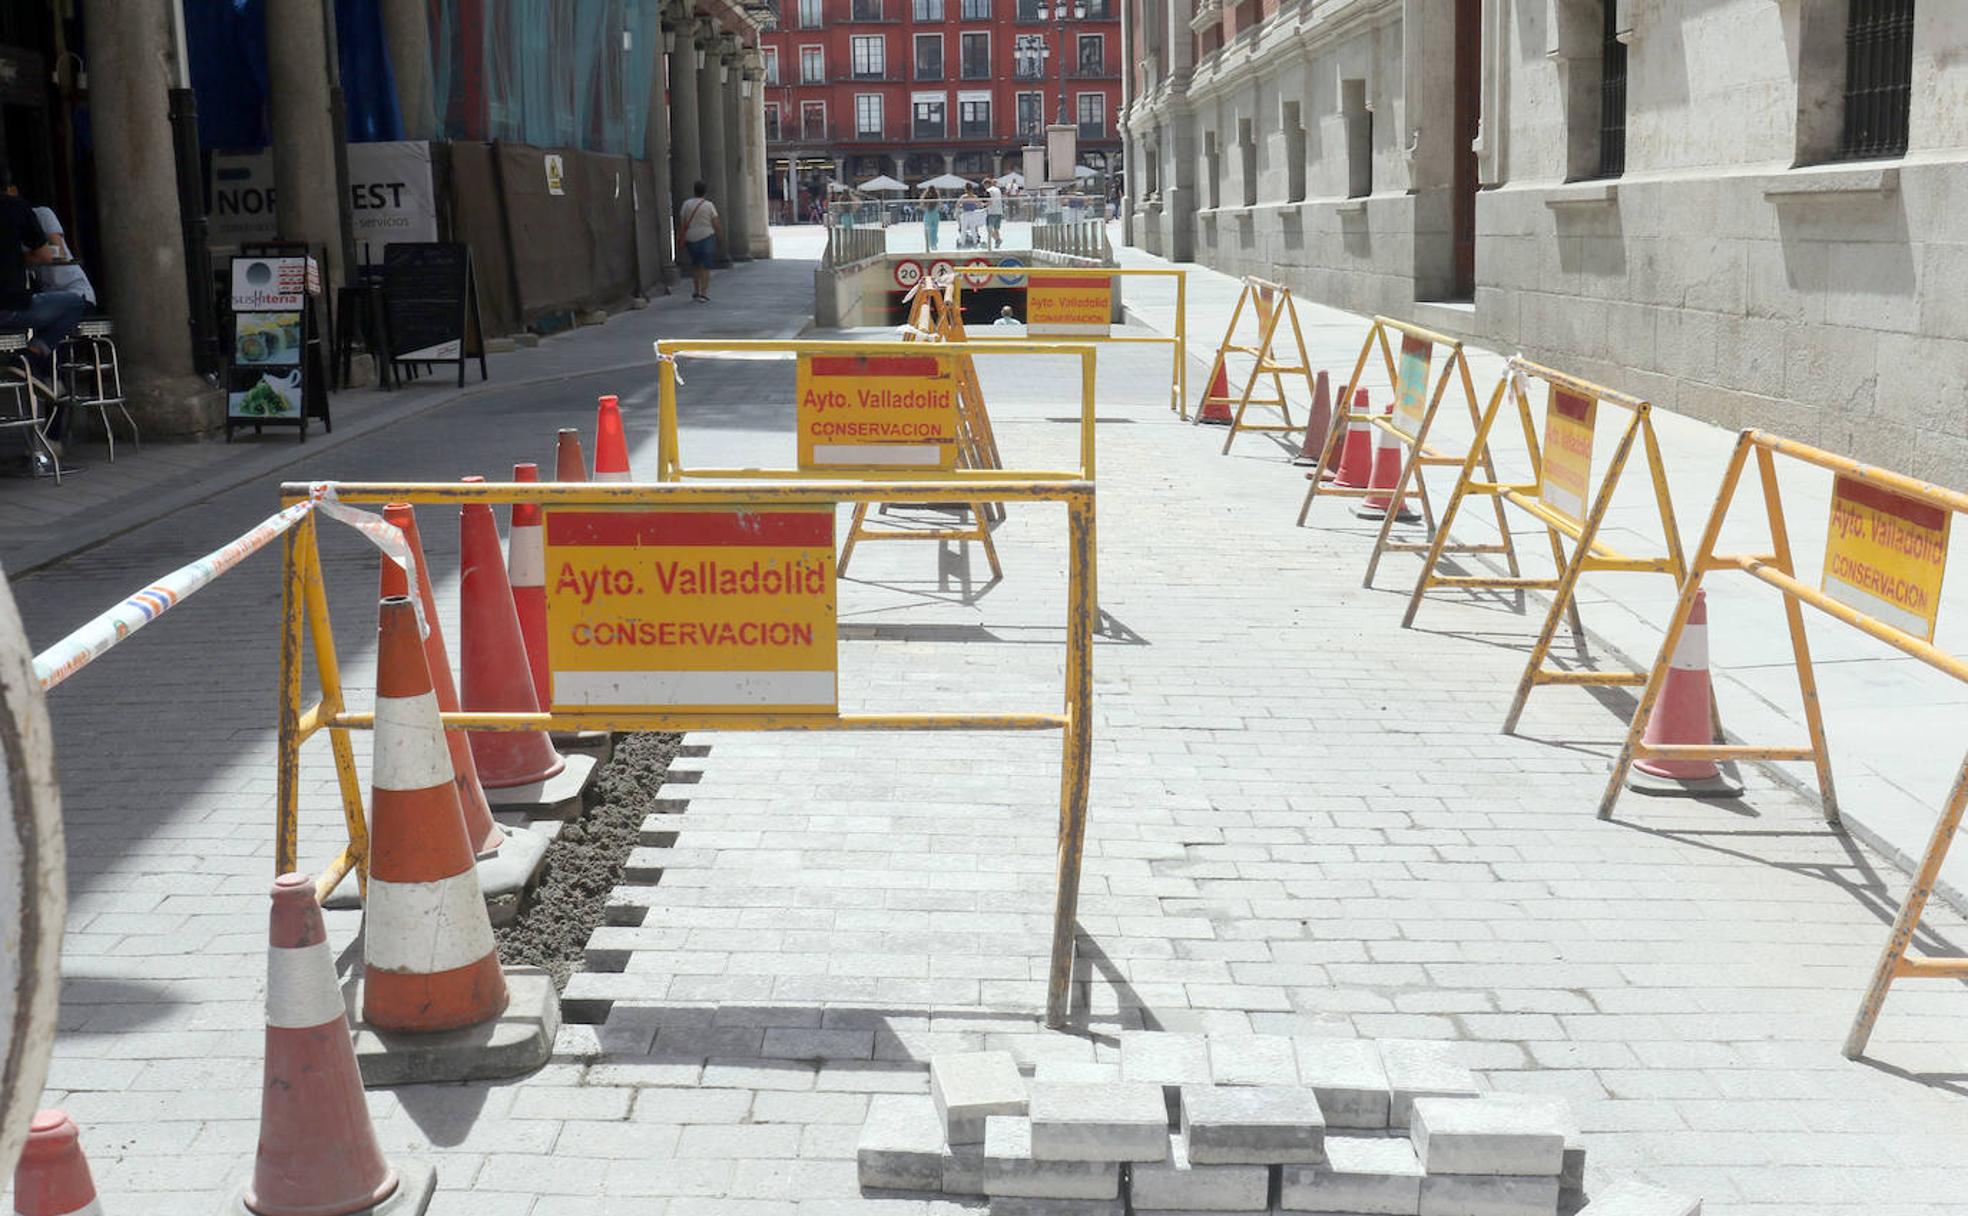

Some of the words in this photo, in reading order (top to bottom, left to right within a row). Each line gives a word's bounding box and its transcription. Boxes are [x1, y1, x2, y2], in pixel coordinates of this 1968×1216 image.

[901, 269, 917, 279] 20
[803, 389, 851, 413] Ayto.
[857, 389, 950, 409] Valladolid
[811, 422, 942, 436] CONSERVACION
[1832, 501, 1866, 539] Ayto.
[1870, 511, 1944, 566] Valladolid
[555, 561, 644, 605] Ayto.
[655, 560, 826, 596] Valladolid
[1832, 553, 1929, 608] CONSERVACION
[571, 622, 814, 647] CONSERVACION
